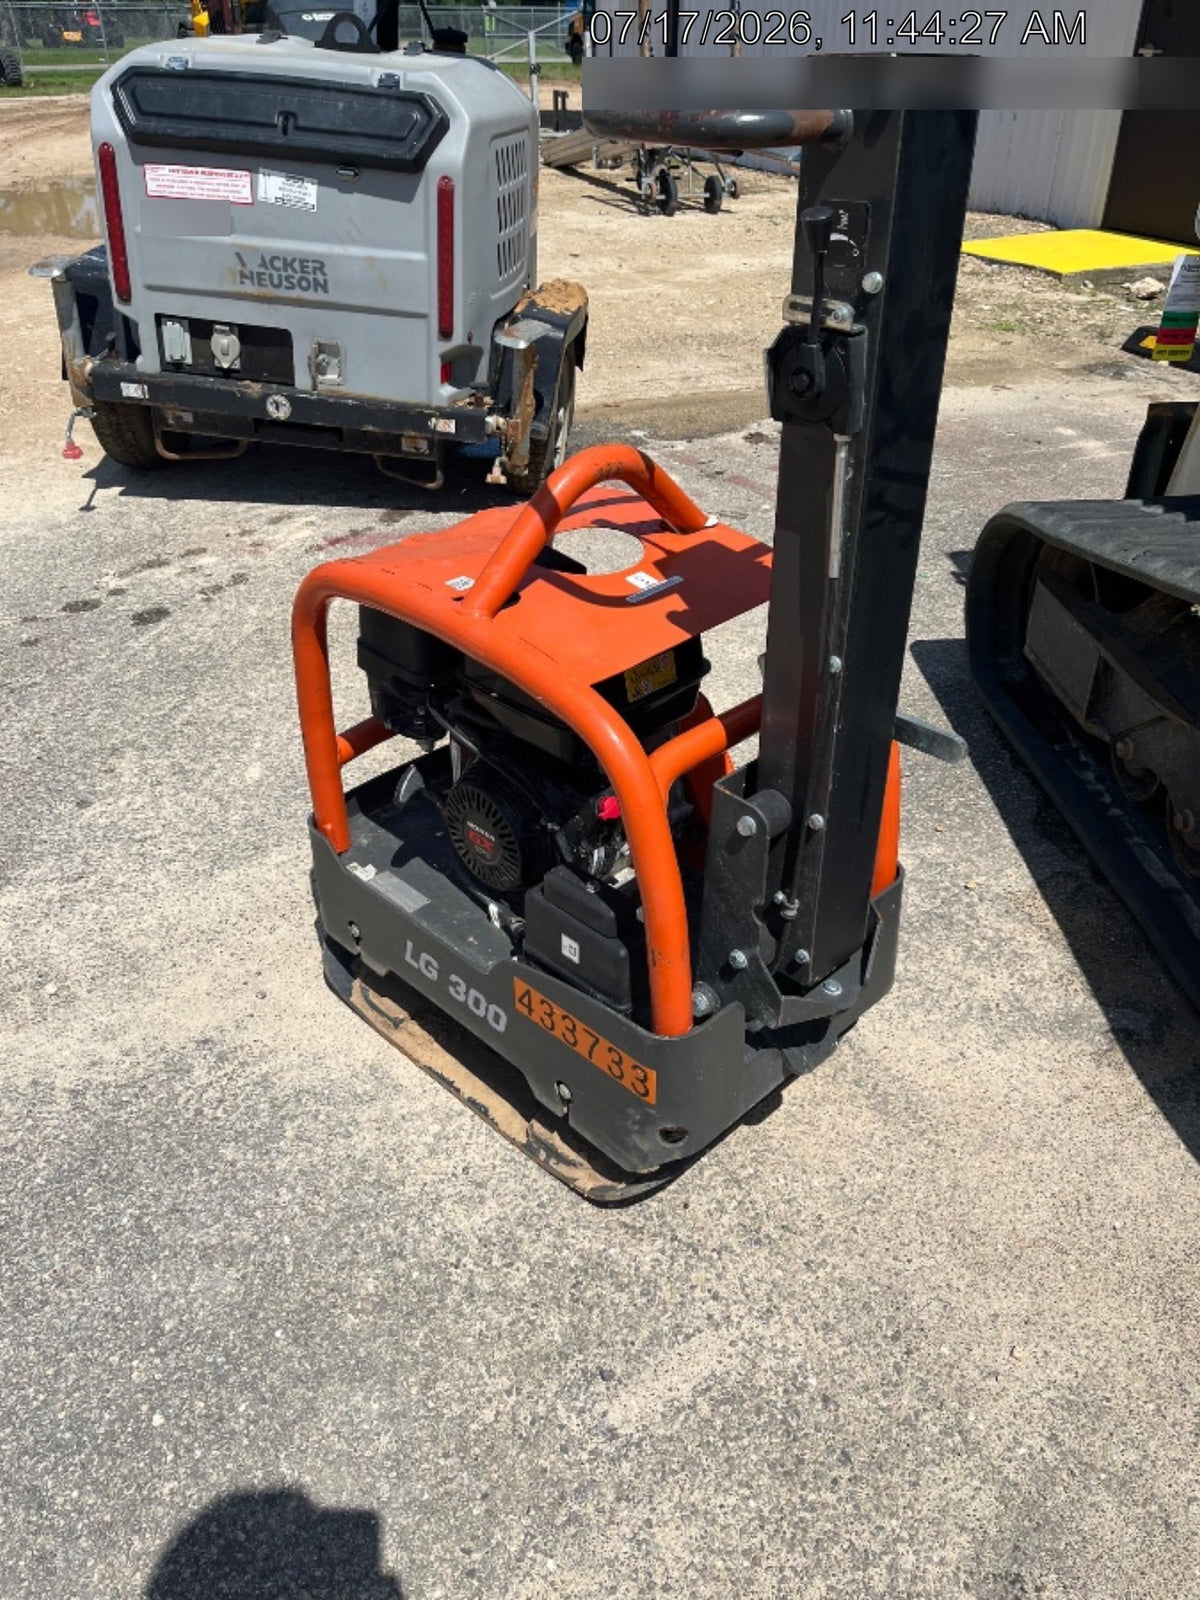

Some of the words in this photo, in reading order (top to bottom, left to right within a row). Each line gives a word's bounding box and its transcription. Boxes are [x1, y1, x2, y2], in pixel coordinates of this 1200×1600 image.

[239, 270, 329, 294] NEUSON
[404, 940, 440, 982] LG
[448, 974, 508, 1033] 300
[517, 988, 651, 1098] 433733
